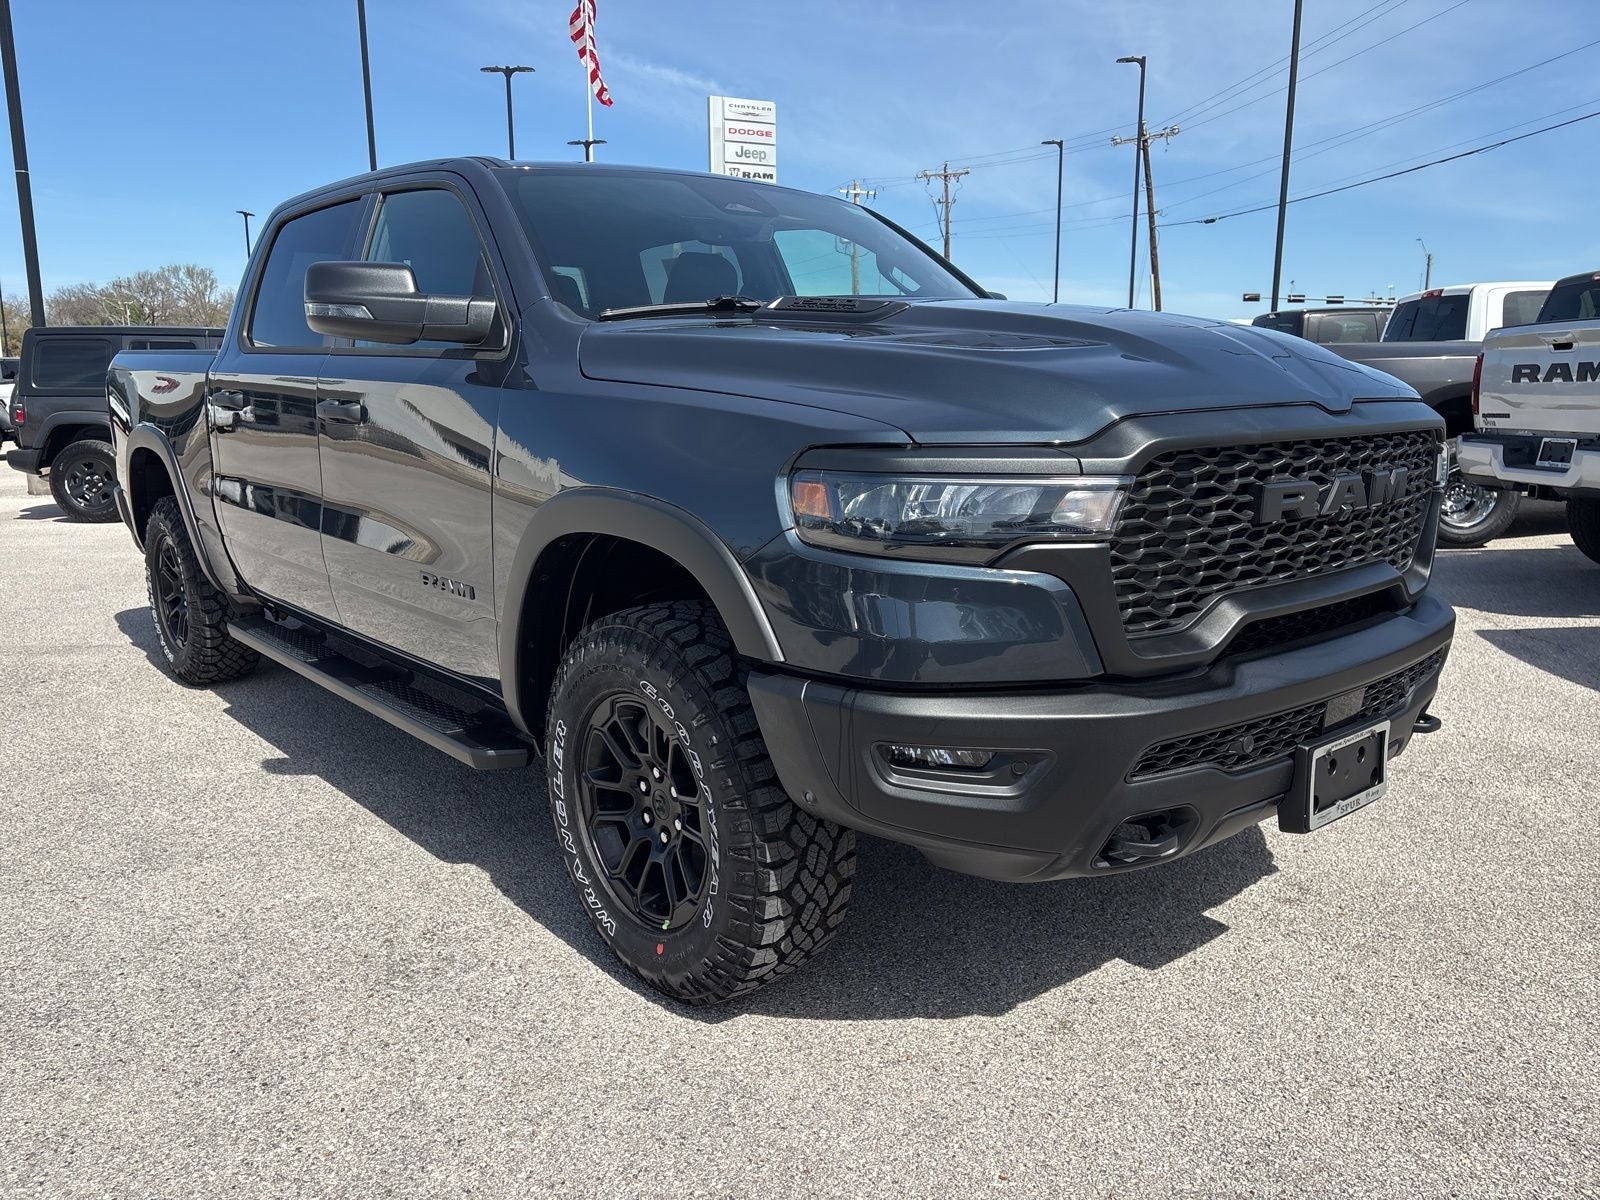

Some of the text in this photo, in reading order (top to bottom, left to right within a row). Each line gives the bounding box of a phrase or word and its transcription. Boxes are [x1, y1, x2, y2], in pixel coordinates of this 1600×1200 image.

[728, 103, 772, 112] CHRYSLER
[728, 127, 773, 138] DODGE
[735, 145, 767, 162] Jeep
[742, 171, 774, 180] RAM
[1257, 467, 1409, 524] RAM
[419, 570, 476, 600] RAM
[639, 680, 719, 928] GOODYEAR
[1340, 798, 1361, 814] SPUR
[553, 719, 616, 936] WRANGLER
